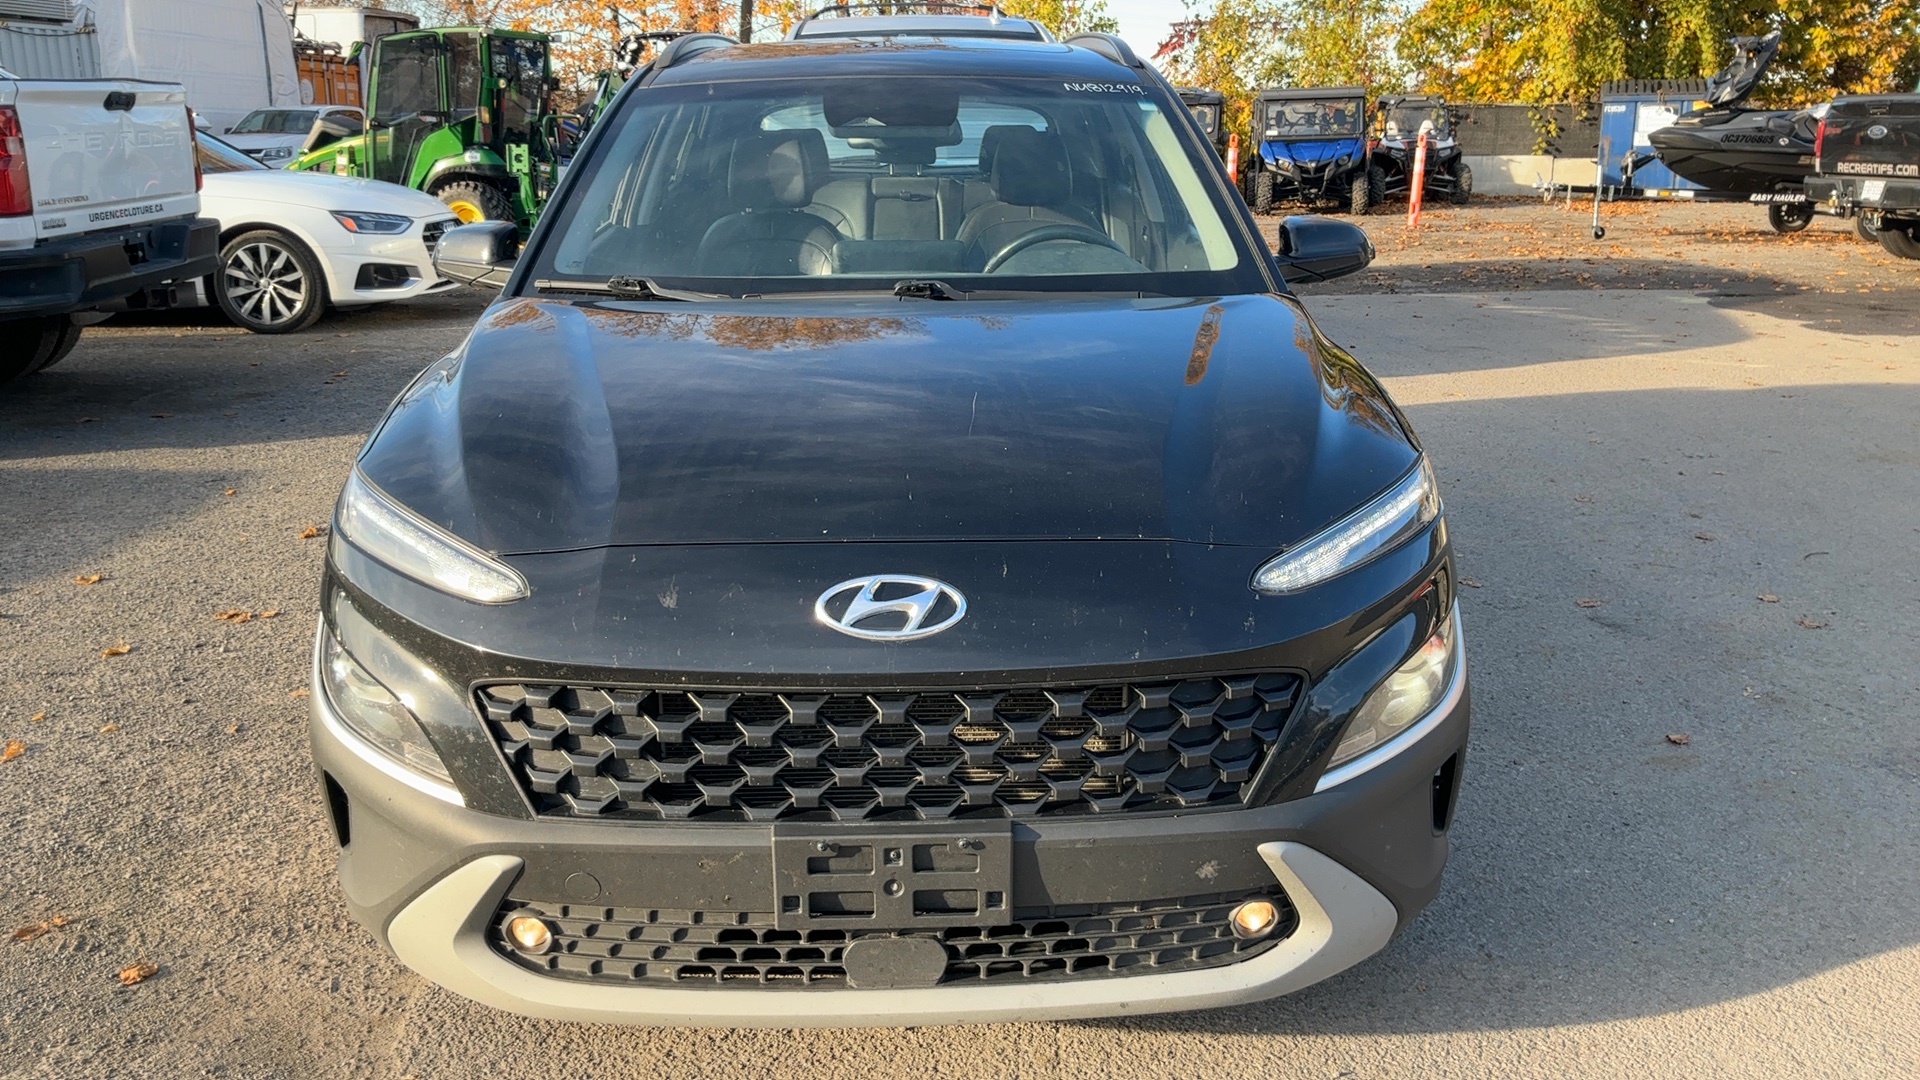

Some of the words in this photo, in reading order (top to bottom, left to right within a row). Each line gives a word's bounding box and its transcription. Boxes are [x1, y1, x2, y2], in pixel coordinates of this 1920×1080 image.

[1750, 193, 1773, 202] EASY
[1773, 194, 1806, 202] HAULER
[88, 204, 164, 223] URGENCECLOTURE.CA
